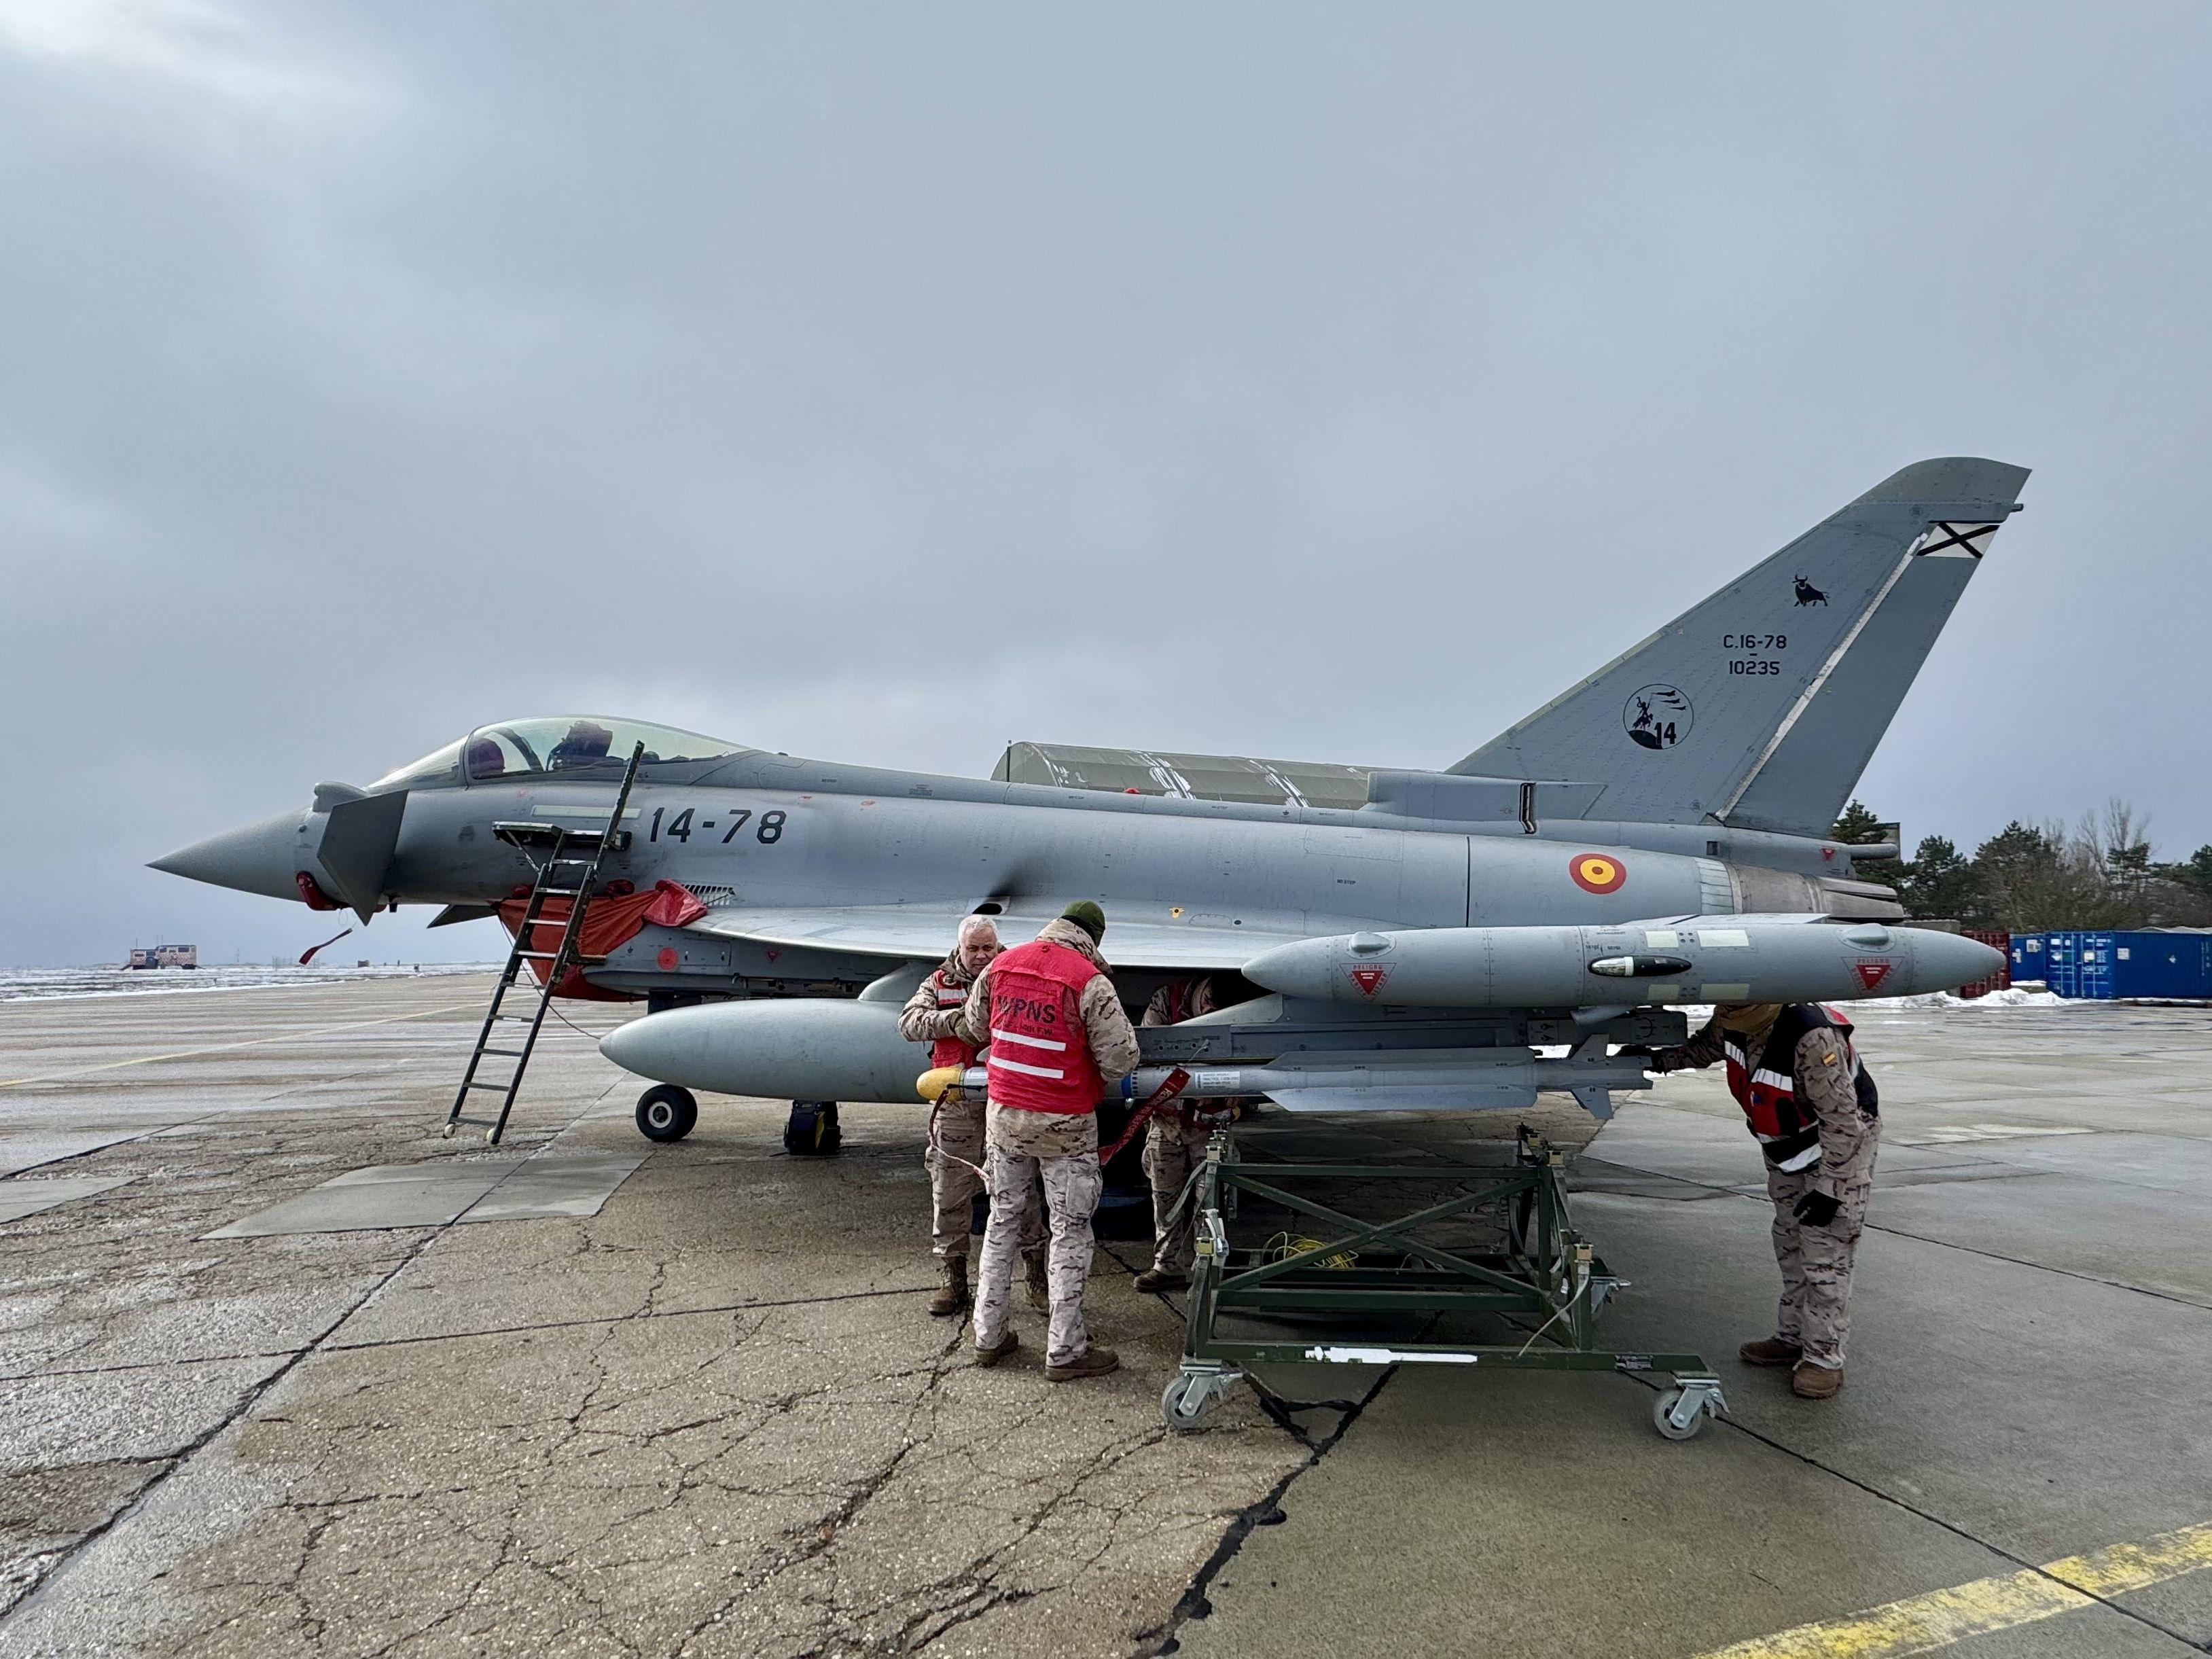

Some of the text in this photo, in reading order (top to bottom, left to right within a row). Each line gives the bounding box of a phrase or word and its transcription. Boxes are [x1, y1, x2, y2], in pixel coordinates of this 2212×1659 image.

[1724, 635, 1787, 649] C.16-78
[1729, 660, 1780, 675] 10235
[1654, 722, 1677, 745] 14
[650, 807, 787, 844] 14-78
[997, 995, 1056, 1024] WPNS
